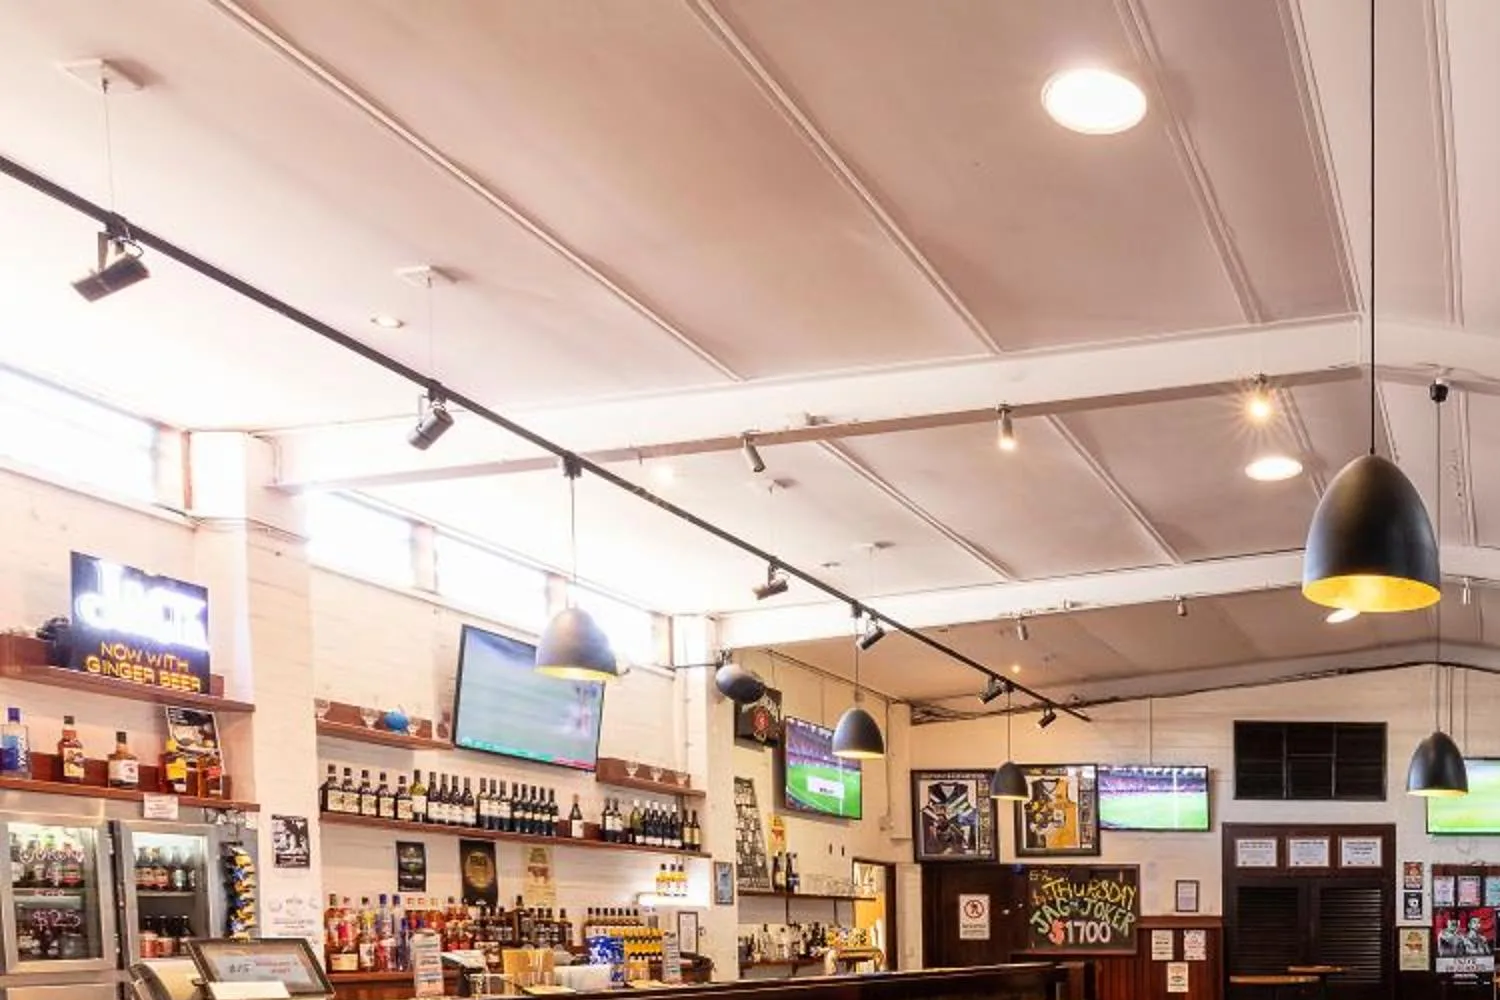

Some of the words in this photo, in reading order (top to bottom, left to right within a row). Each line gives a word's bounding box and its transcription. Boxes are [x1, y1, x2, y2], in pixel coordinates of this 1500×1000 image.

[101, 641, 141, 663] NOW
[146, 652, 189, 672] WITH
[86, 656, 155, 684] GINGER
[159, 670, 201, 692] BEER
[1048, 919, 1111, 945] $1700
[1080, 897, 1136, 937] JOKER
